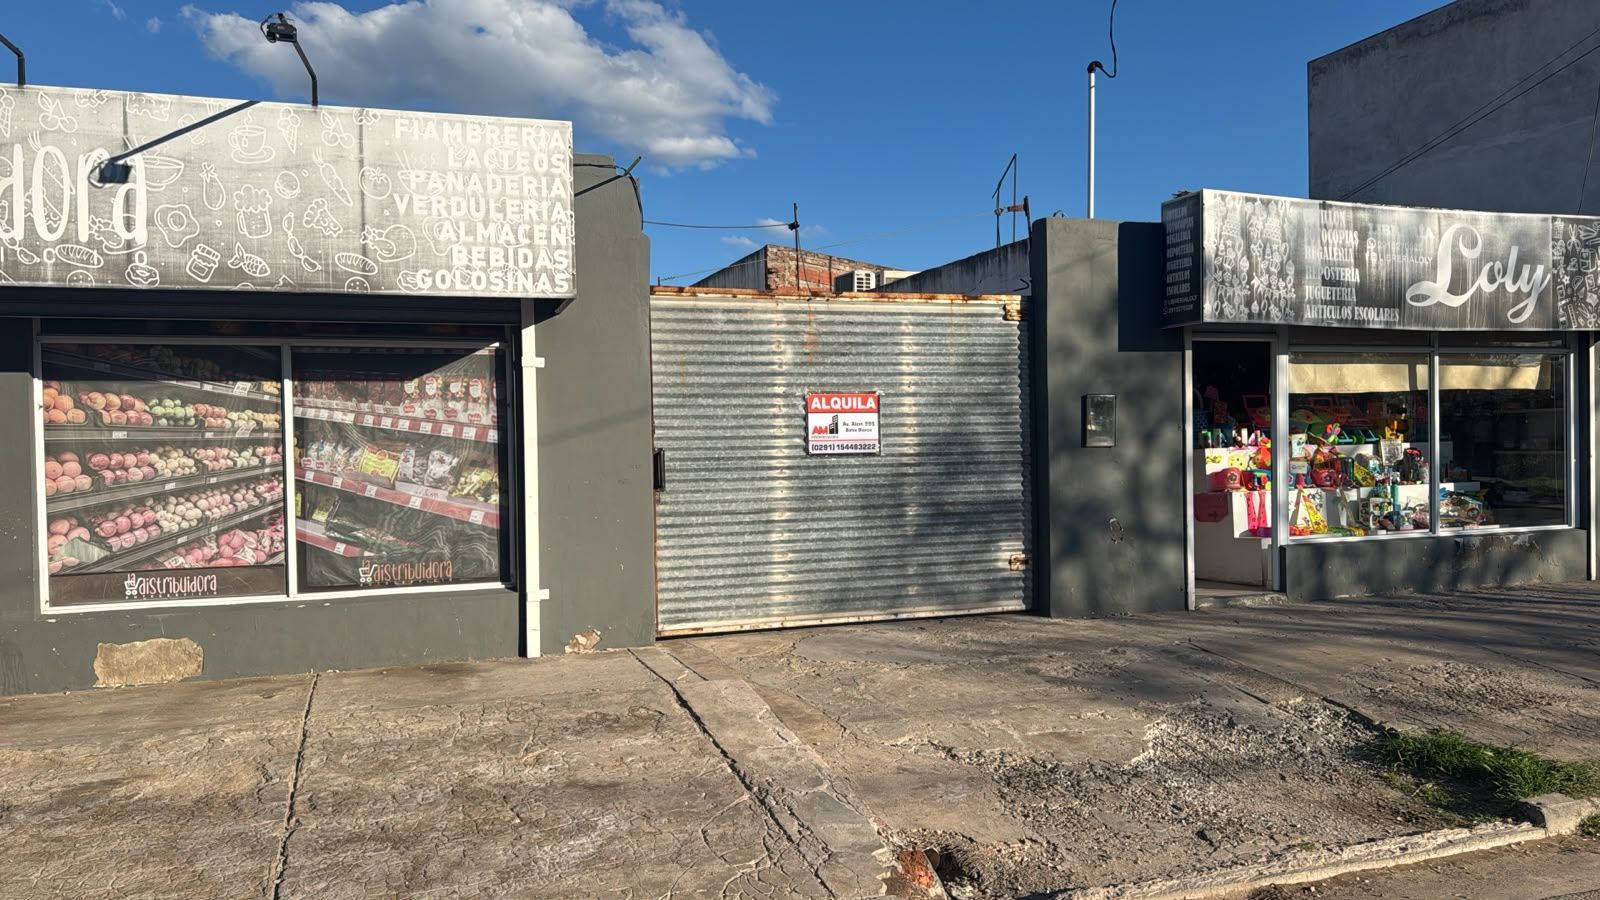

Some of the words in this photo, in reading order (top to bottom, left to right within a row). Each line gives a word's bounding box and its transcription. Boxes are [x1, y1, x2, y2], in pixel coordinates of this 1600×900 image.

[394, 118, 566, 149] FIAMBRERIA
[447, 147, 565, 174] LACTEOS
[411, 171, 566, 198] PANADERIA
[393, 193, 567, 222] VERDULERIA
[440, 221, 568, 245] ALMACEN
[452, 246, 569, 270] BEBIDAS
[416, 269, 569, 293] GOLOSINAS
[1406, 223, 1551, 323] Loly
[1305, 285, 1357, 301] JUGUETERIA
[1304, 304, 1352, 320] ARTICULOS
[1354, 306, 1399, 321] ESCOLARES
[811, 396, 876, 410] ALQUILA
[812, 425, 828, 435] AM
[811, 444, 835, 452] (0291)
[373, 560, 453, 582] distribuidora
[139, 574, 217, 595] distribuidora
